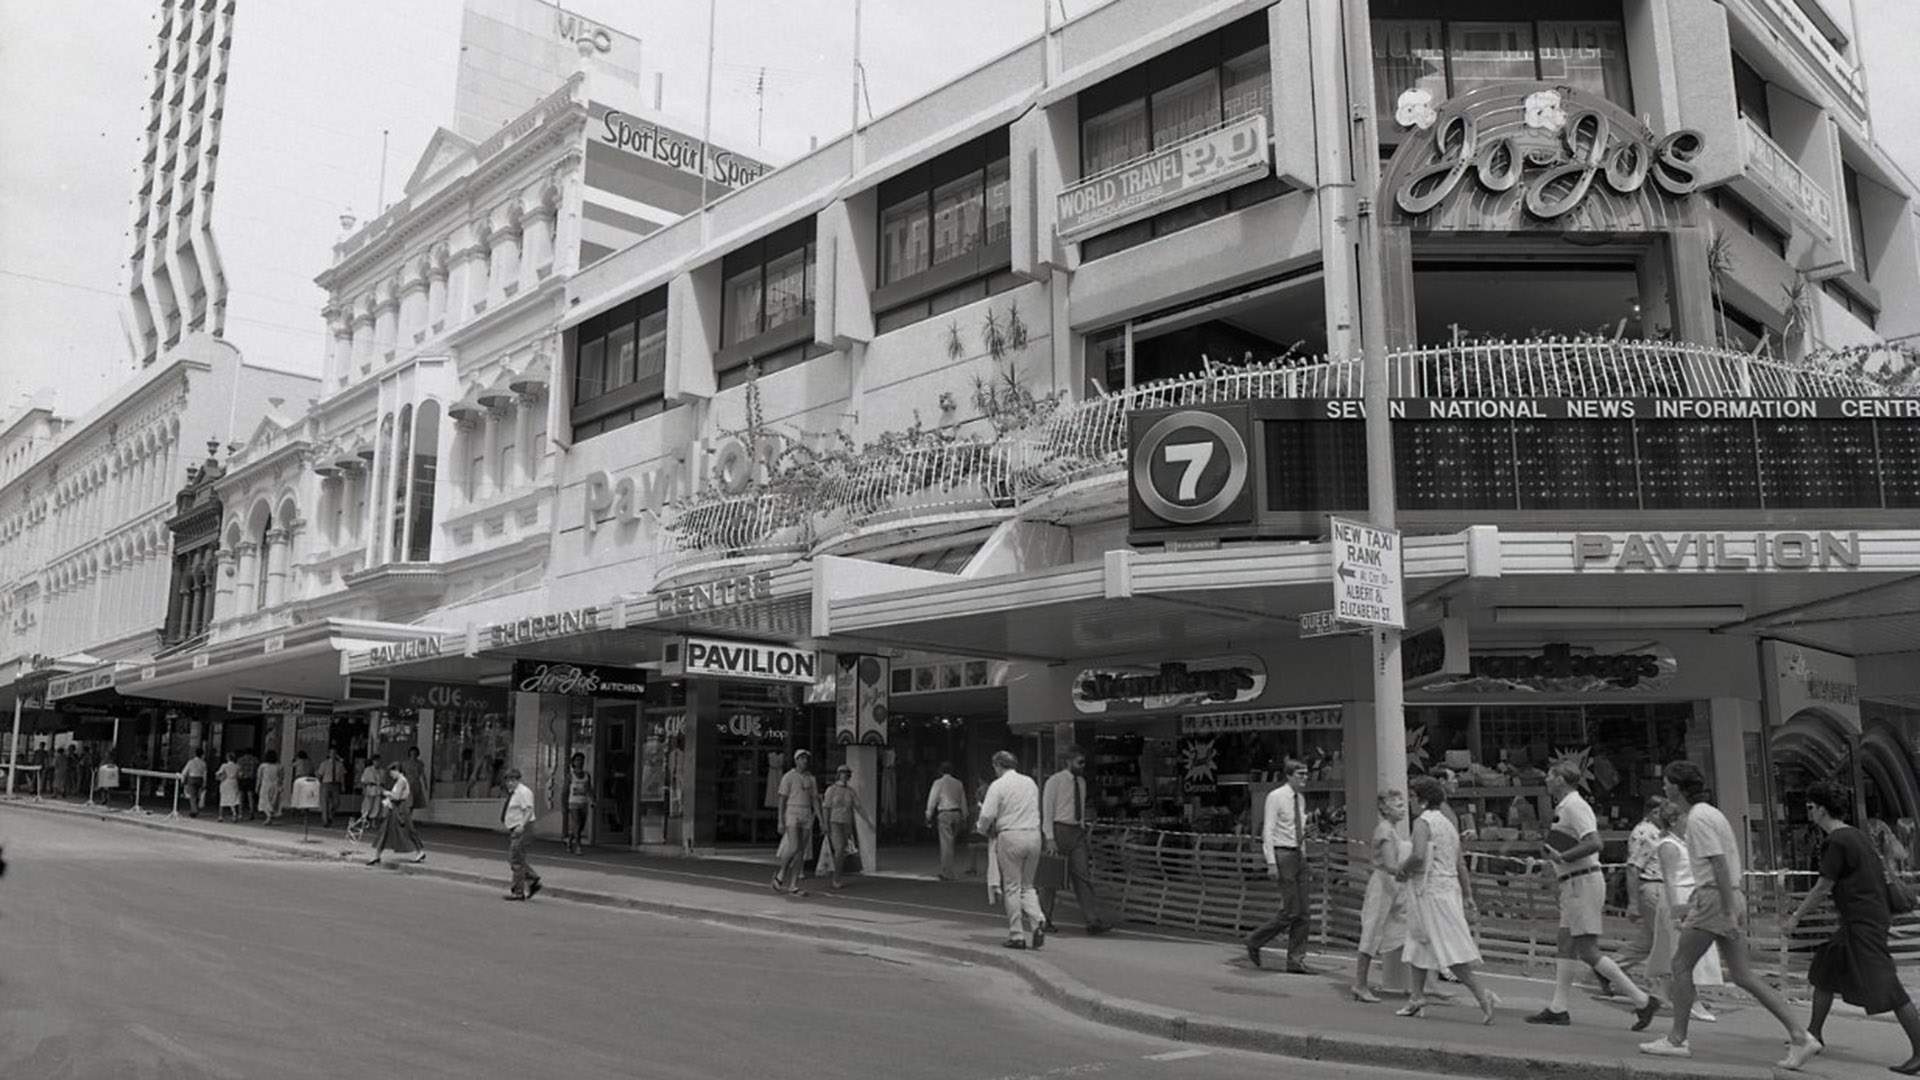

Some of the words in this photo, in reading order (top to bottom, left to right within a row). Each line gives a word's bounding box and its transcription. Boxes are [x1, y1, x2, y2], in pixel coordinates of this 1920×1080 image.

[601, 110, 705, 175] Sportsgirl
[1060, 178, 1116, 219] WORLD
[1119, 154, 1182, 200] TRAVEL
[1327, 400, 1406, 419] SEVN
[1430, 400, 1547, 418] NATIONAL
[1567, 400, 1635, 418] NEWS
[1655, 399, 1818, 418] INFORMATION
[1165, 441, 1214, 501] 7
[1335, 524, 1362, 544] NEW
[1365, 530, 1393, 551] TAXI
[1347, 545, 1382, 568] RANK
[1572, 532, 1861, 570] PAVILION
[1346, 585, 1374, 602] ALBERT
[369, 633, 443, 666] PAVILION
[490, 605, 599, 646] SHOPPING
[656, 570, 775, 616] CENTRE
[1340, 600, 1380, 620] ELIZABETH
[689, 643, 814, 677] PAVILION
[428, 686, 462, 708] CUE
[600, 682, 645, 694] KITCHEN
[729, 715, 762, 737] CUE
